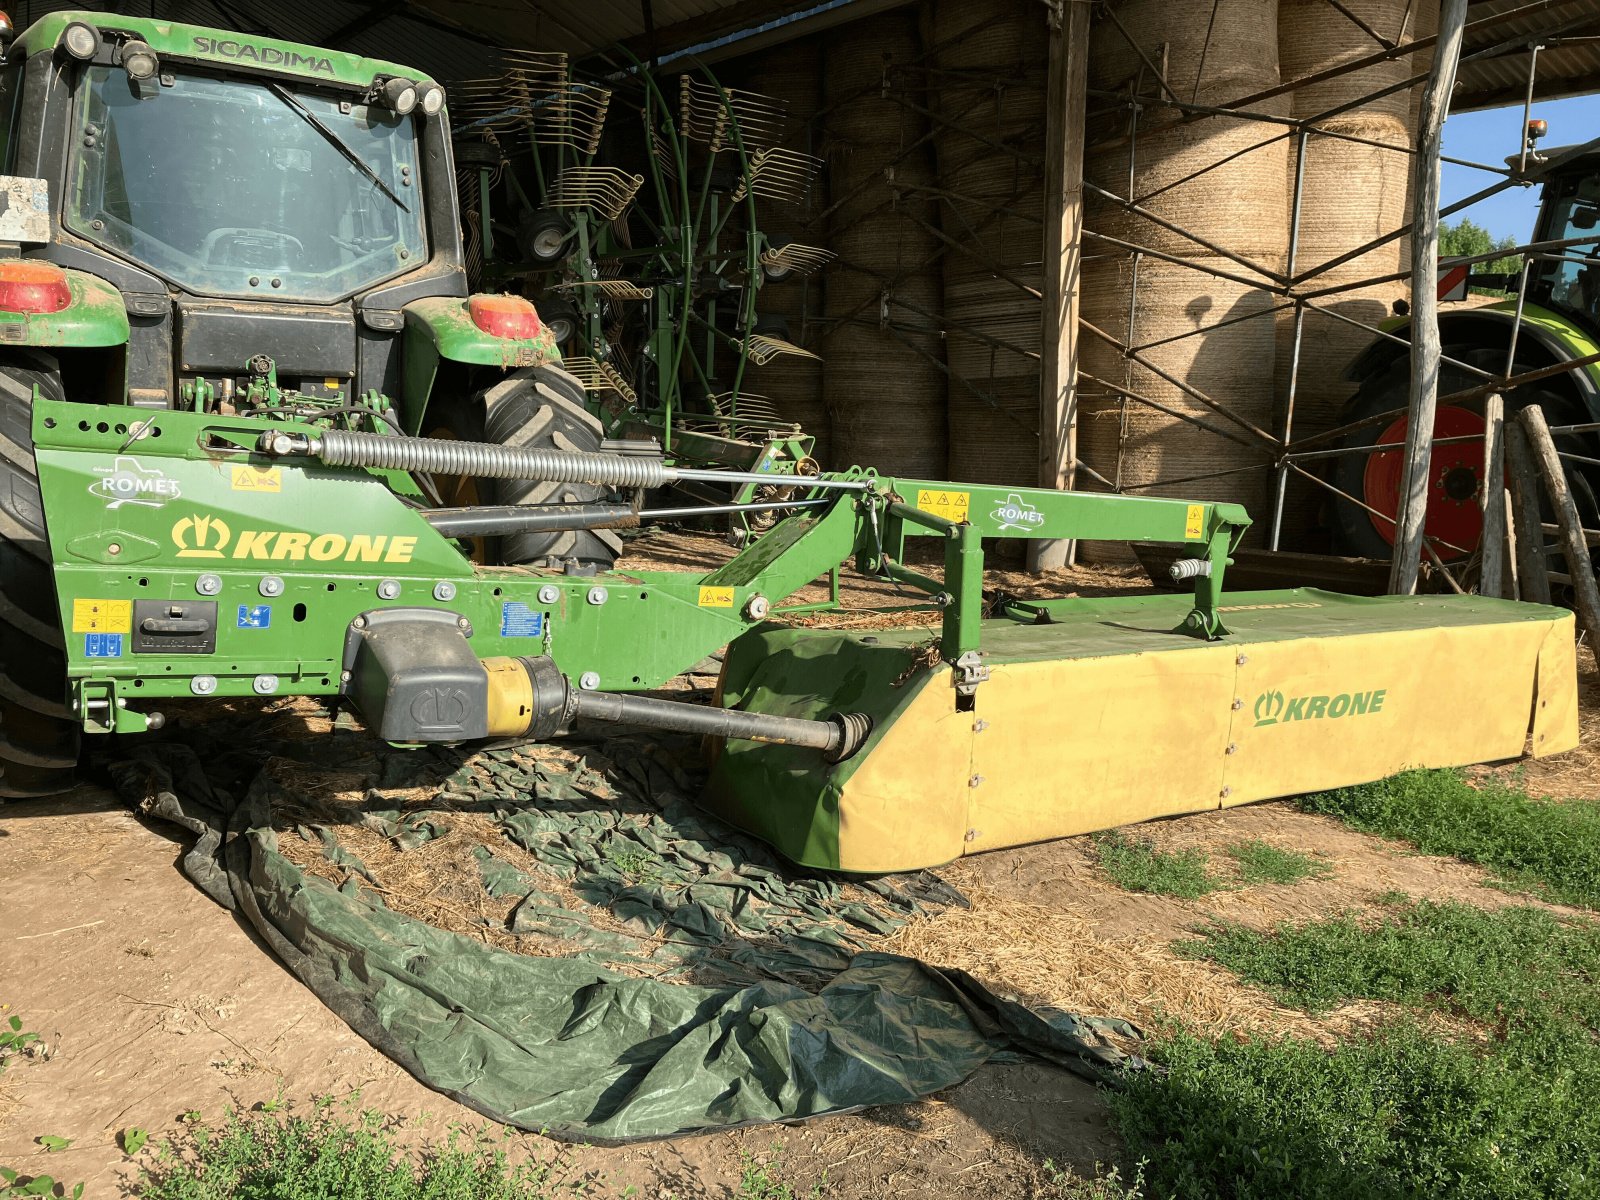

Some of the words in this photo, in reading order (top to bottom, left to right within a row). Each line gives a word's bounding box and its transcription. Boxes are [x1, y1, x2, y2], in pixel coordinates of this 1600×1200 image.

[193, 36, 336, 75] SICADIMA
[102, 477, 180, 493] ROMET
[997, 507, 1045, 523] ROMET
[232, 530, 418, 563] KRONE
[1282, 689, 1387, 722] KRONE
